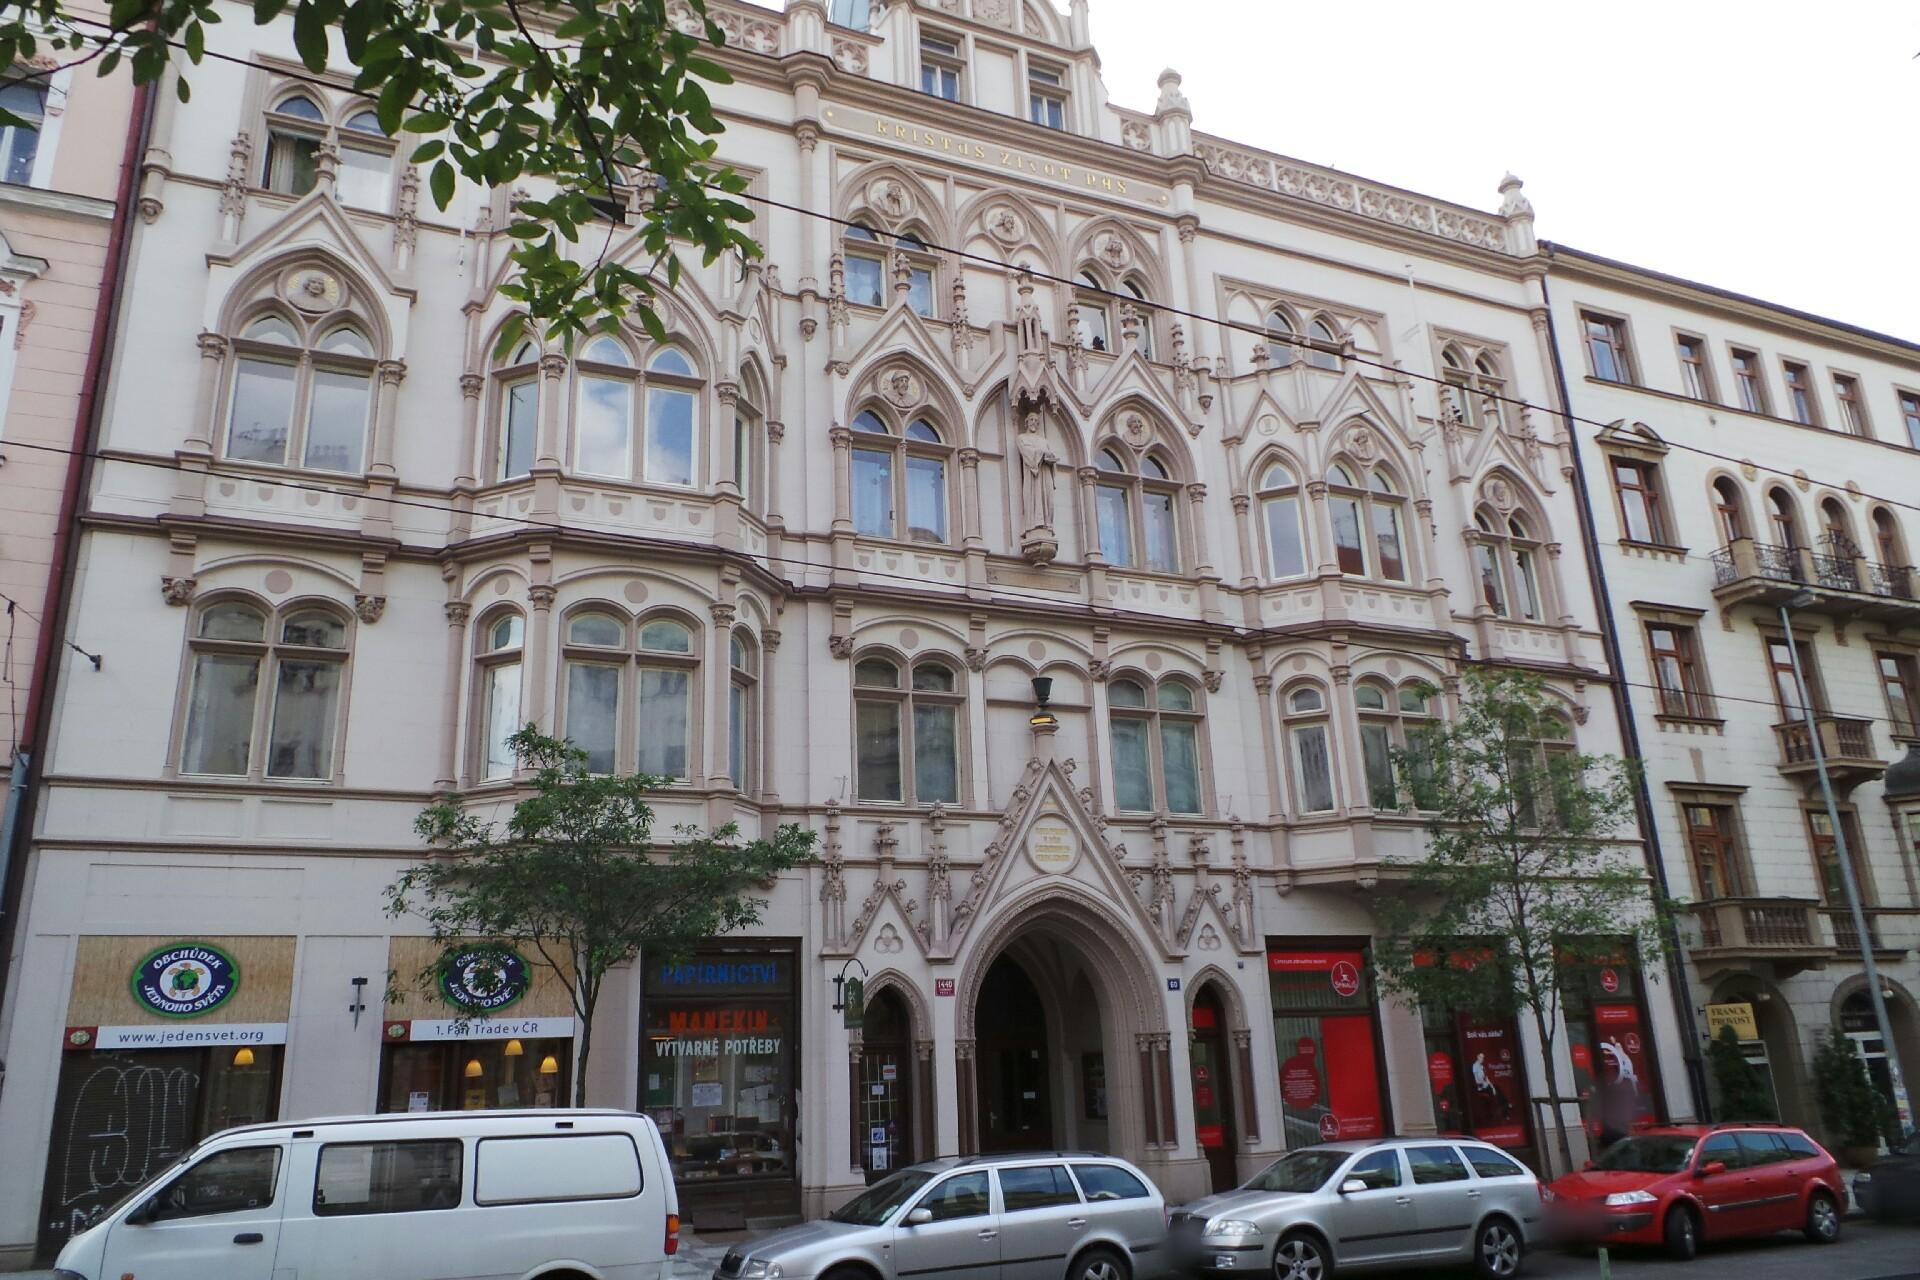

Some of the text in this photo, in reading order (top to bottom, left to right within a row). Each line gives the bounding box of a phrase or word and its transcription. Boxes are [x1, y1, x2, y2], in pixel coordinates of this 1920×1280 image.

[153, 947, 222, 969] OBCHŮDEK
[662, 960, 778, 985] PAPÍRNICTVÍ
[144, 983, 226, 1012] JEDNOHO SVĚTA
[669, 1010, 768, 1034] MANEKIN
[1711, 1007, 1746, 1016] FRANCK
[119, 1030, 264, 1044] www.jedensvet.org
[436, 1025, 444, 1035] 1.
[475, 1023, 509, 1035] Trade
[522, 1021, 538, 1033] ČR
[655, 1036, 781, 1057] VÝTVARNÉ POTŘEBY
